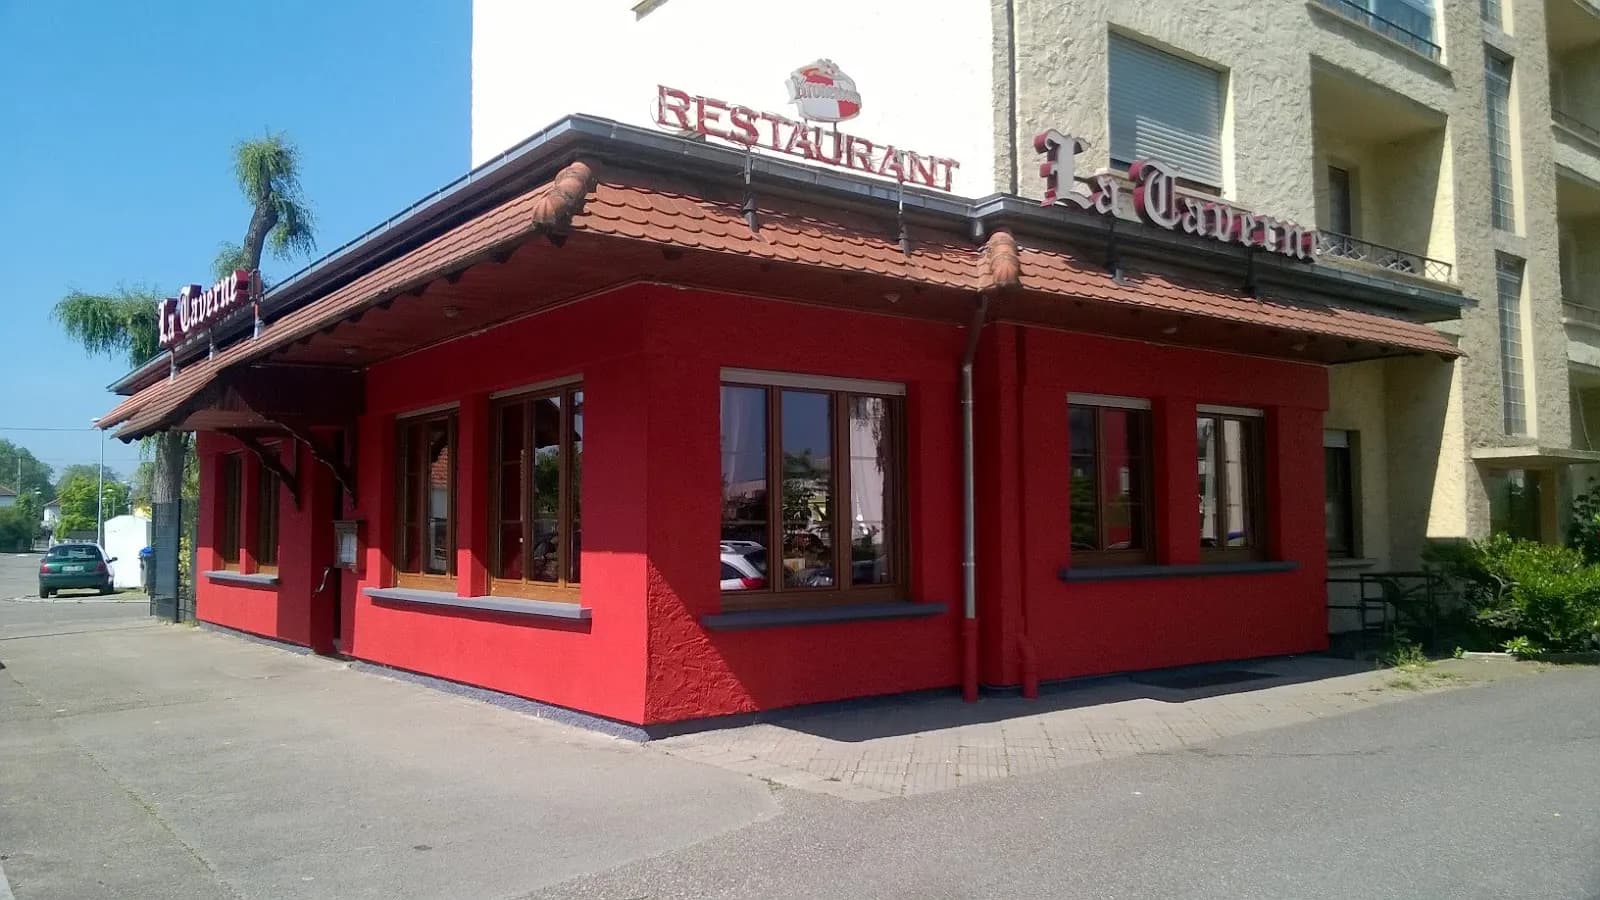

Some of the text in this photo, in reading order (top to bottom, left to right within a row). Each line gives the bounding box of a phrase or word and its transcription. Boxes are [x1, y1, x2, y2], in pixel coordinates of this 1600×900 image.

[657, 84, 960, 192] RESTAURANT
[1034, 128, 1123, 218] La
[158, 269, 241, 343] La Taverne
